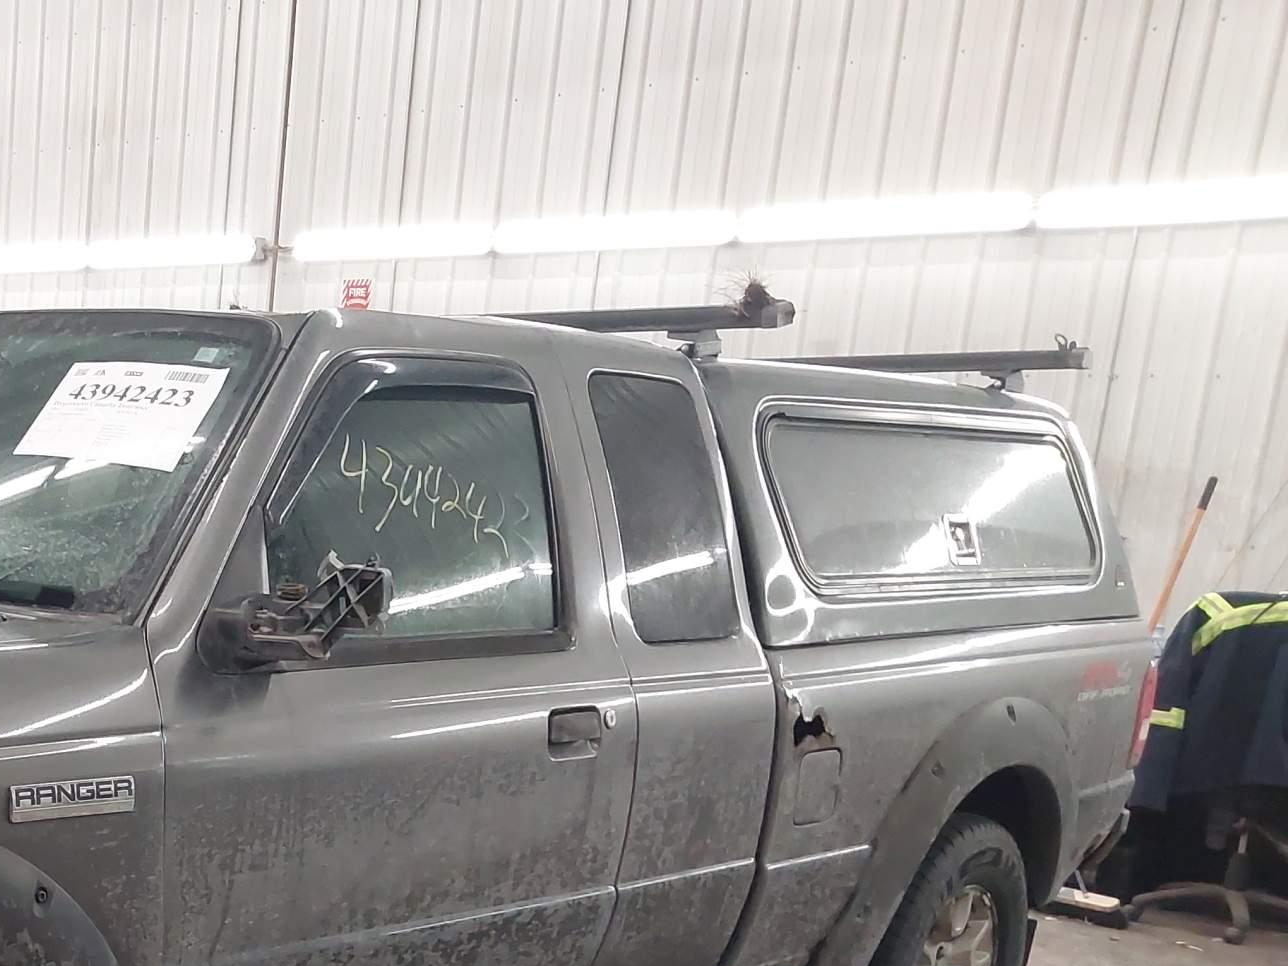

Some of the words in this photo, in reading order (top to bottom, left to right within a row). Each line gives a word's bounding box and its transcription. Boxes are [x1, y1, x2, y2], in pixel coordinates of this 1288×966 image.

[348, 287, 367, 297] FIRE
[68, 383, 195, 408] 43942423
[14, 779, 133, 808] RANGER
